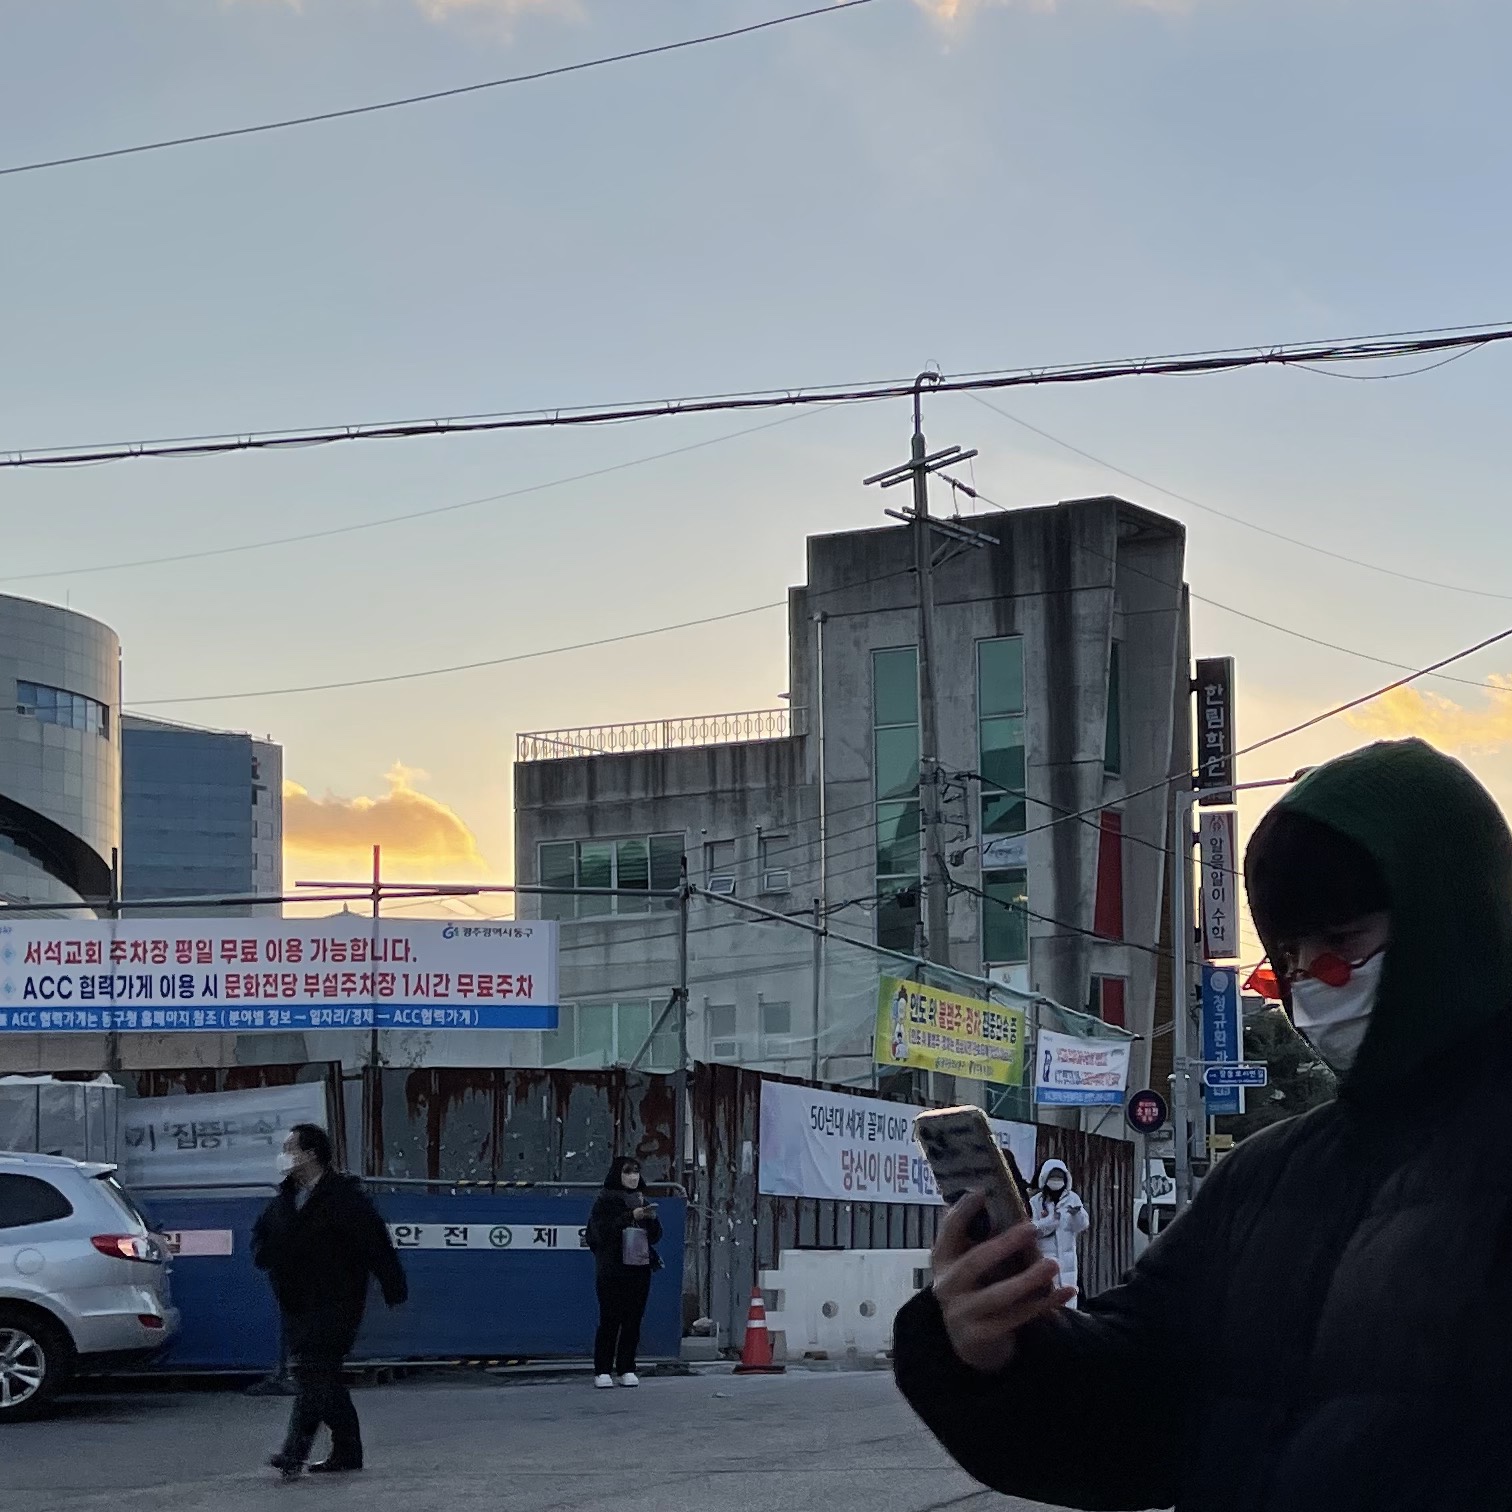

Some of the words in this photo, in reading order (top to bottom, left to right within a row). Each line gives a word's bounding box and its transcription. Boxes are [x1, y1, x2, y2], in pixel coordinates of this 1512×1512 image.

[1204, 684, 1225, 777] 한림학원
[1211, 908, 1226, 941] 수학
[24, 940, 102, 966] 서석교회
[109, 939, 169, 965] 주차장
[175, 939, 213, 965] 평일
[220, 938, 259, 964] 무료
[265, 938, 303, 963] 이용
[310, 937, 418, 963] 가능합니다.
[23, 975, 73, 1000] ACC
[79, 974, 152, 1000] 협력가게
[160, 974, 195, 999] 이용
[202, 973, 218, 999] 시
[224, 973, 298, 999] 문화전당
[304, 973, 396, 998] 부설주차장
[402, 972, 451, 998] 1시간
[457, 973, 534, 999] 무료주차
[11, 1012, 37, 1028] ACC
[40, 1011, 98, 1028] 협력가게는
[102, 1010, 137, 1028] 동구청
[267, 1009, 292, 1025] 정보
[810, 1105, 845, 1138] 50년대
[845, 1108, 866, 1141] 세계
[867, 1113, 887, 1143] 꼴찌
[841, 1149, 881, 1192] 당신이
[884, 1152, 911, 1194] 이룬
[911, 1156, 942, 1195] 대한
